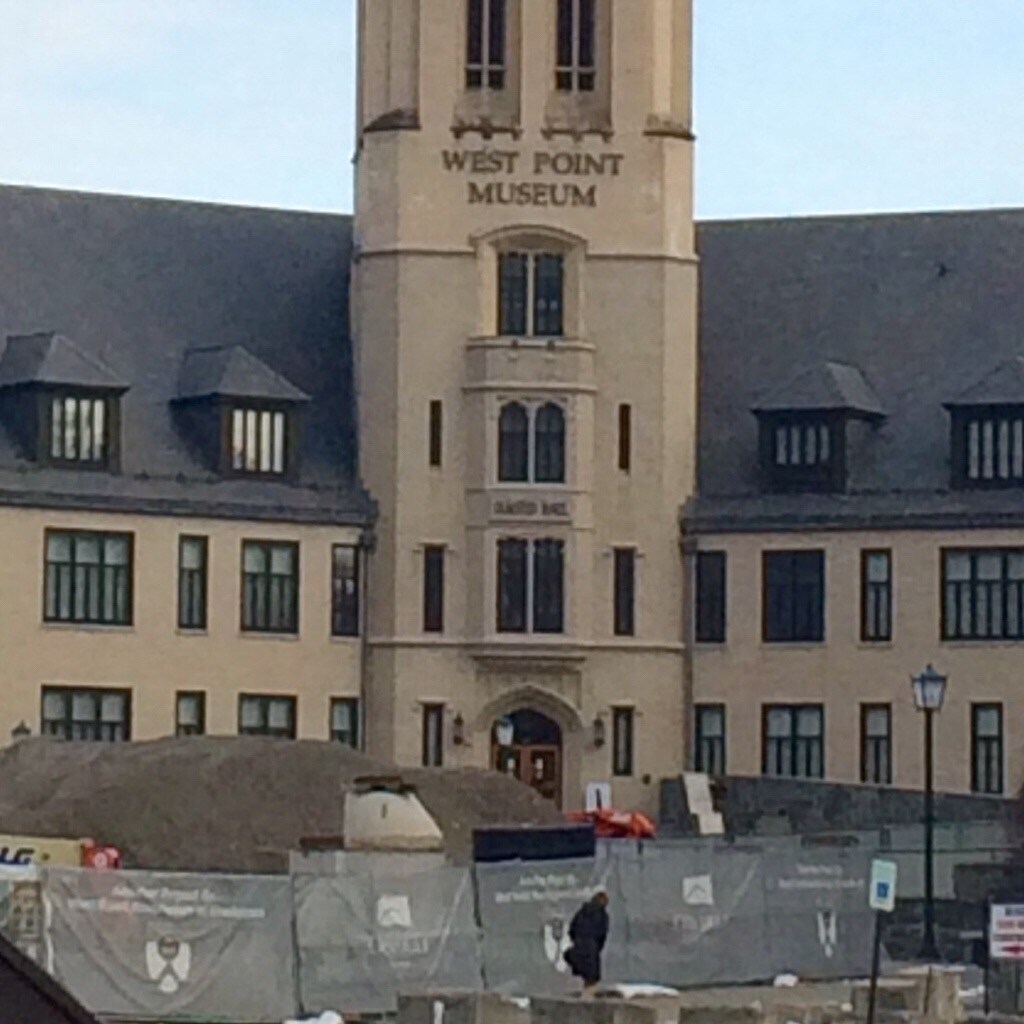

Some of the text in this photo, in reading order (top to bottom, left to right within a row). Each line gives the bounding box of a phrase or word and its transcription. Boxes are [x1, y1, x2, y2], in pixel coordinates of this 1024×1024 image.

[441, 150, 625, 176] WEST POINT
[467, 181, 597, 208] MUSEUM
